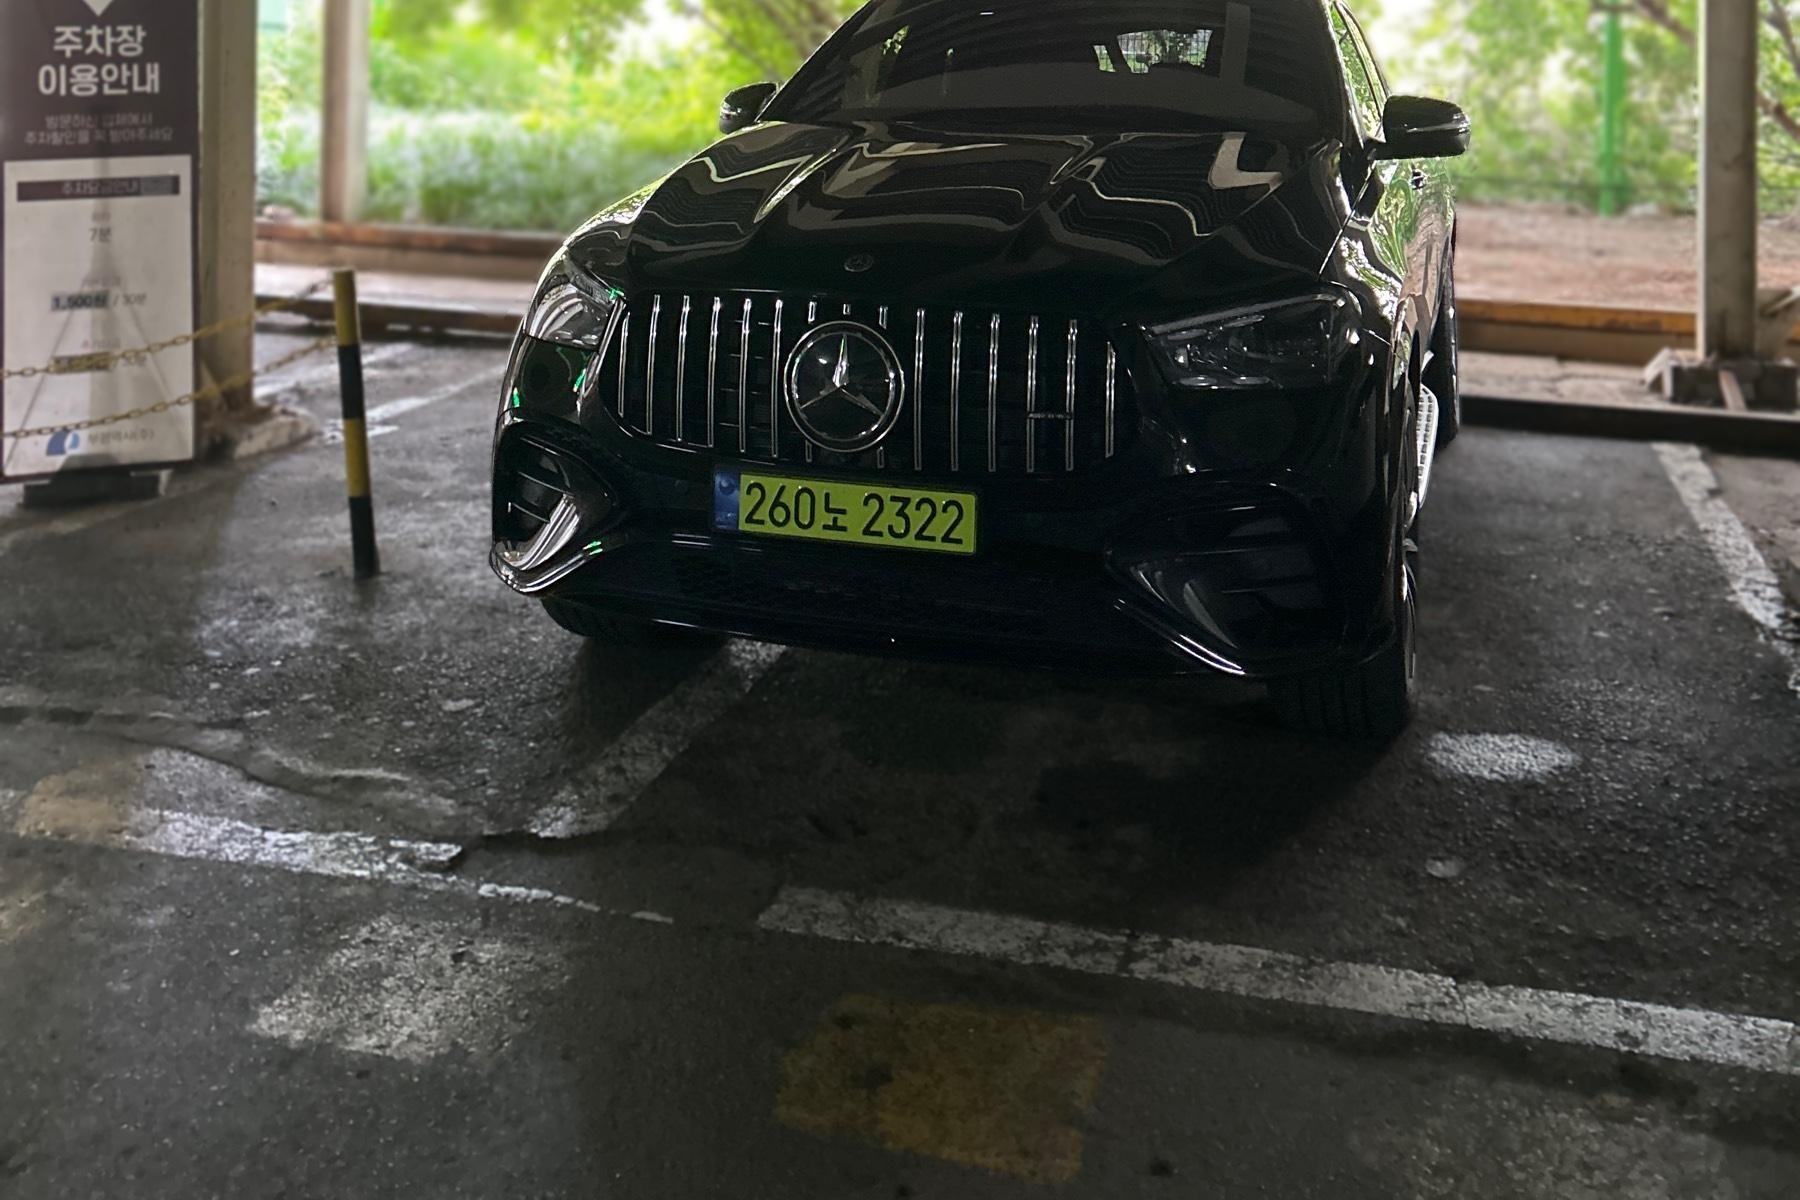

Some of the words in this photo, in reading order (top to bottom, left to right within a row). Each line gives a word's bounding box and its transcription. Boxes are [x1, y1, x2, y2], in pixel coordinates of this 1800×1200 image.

[54, 24, 146, 58] 주차장
[38, 63, 160, 97] 이용안내
[745, 481, 848, 532] 260노
[862, 493, 964, 544] 2322
